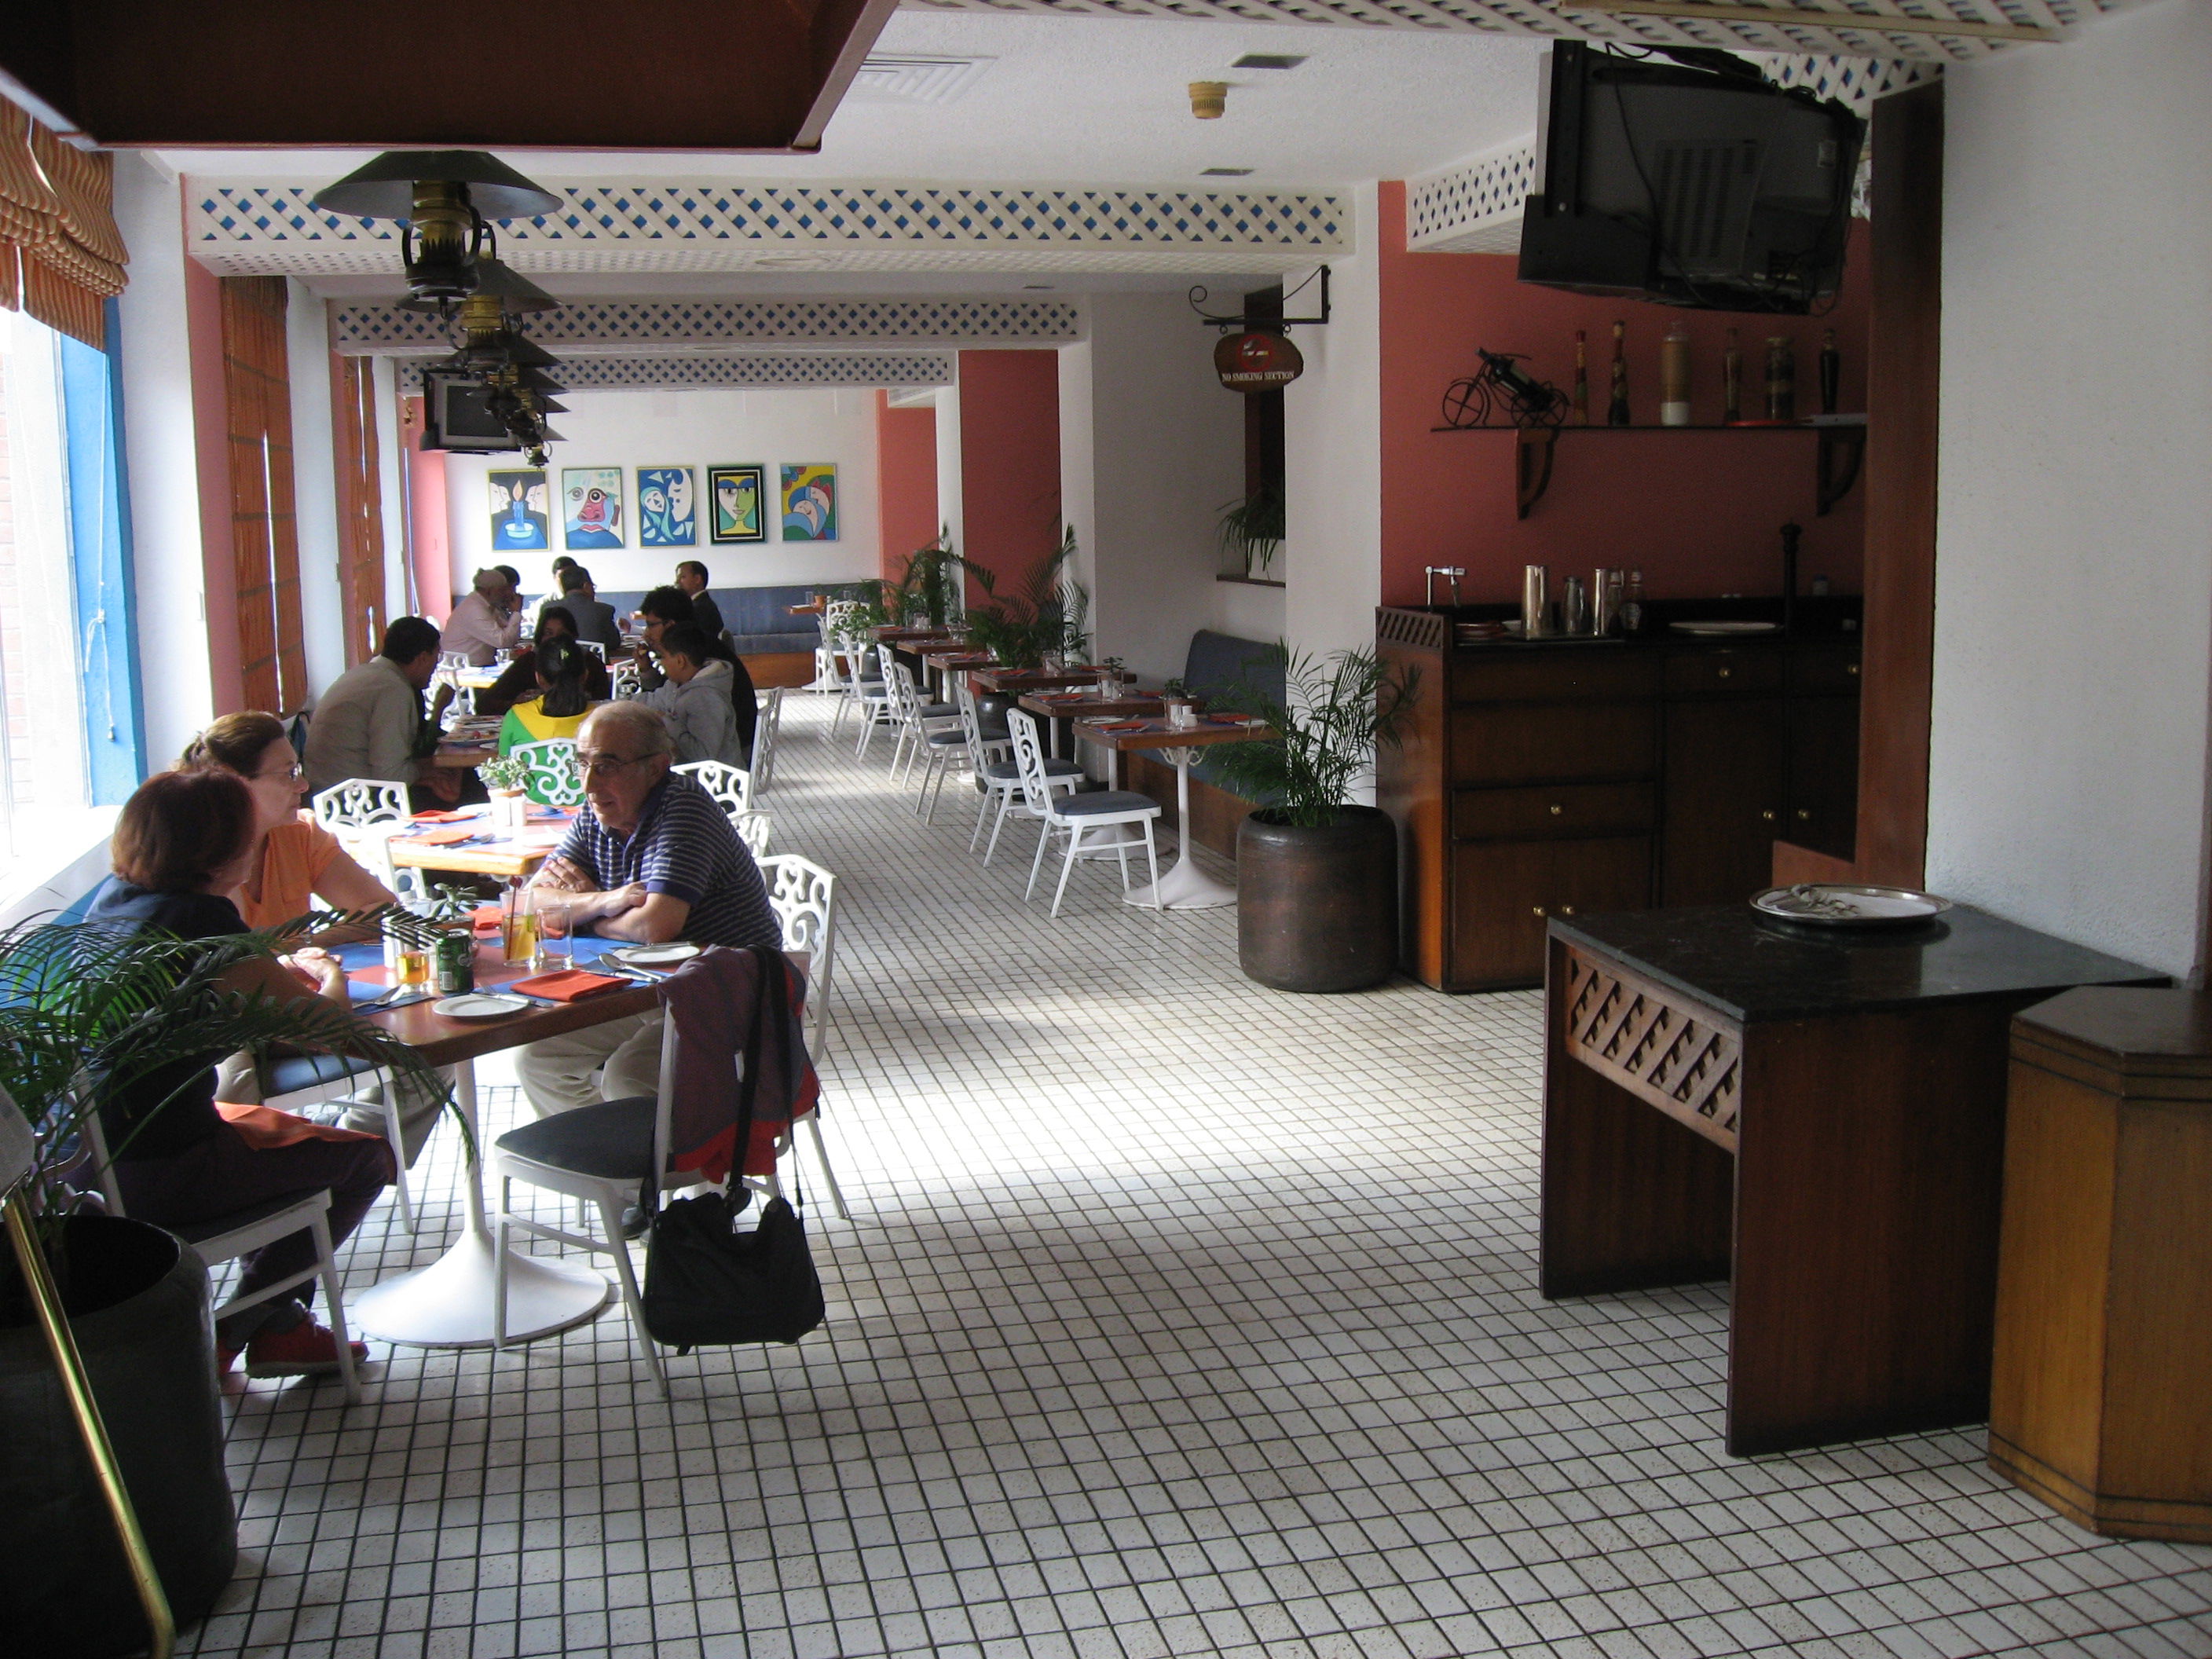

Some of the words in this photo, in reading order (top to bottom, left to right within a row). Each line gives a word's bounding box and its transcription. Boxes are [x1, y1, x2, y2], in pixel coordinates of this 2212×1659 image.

[1221, 373, 1231, 383] NO
[1232, 372, 1263, 382] SMOKING
[1264, 371, 1295, 380] SECTION
